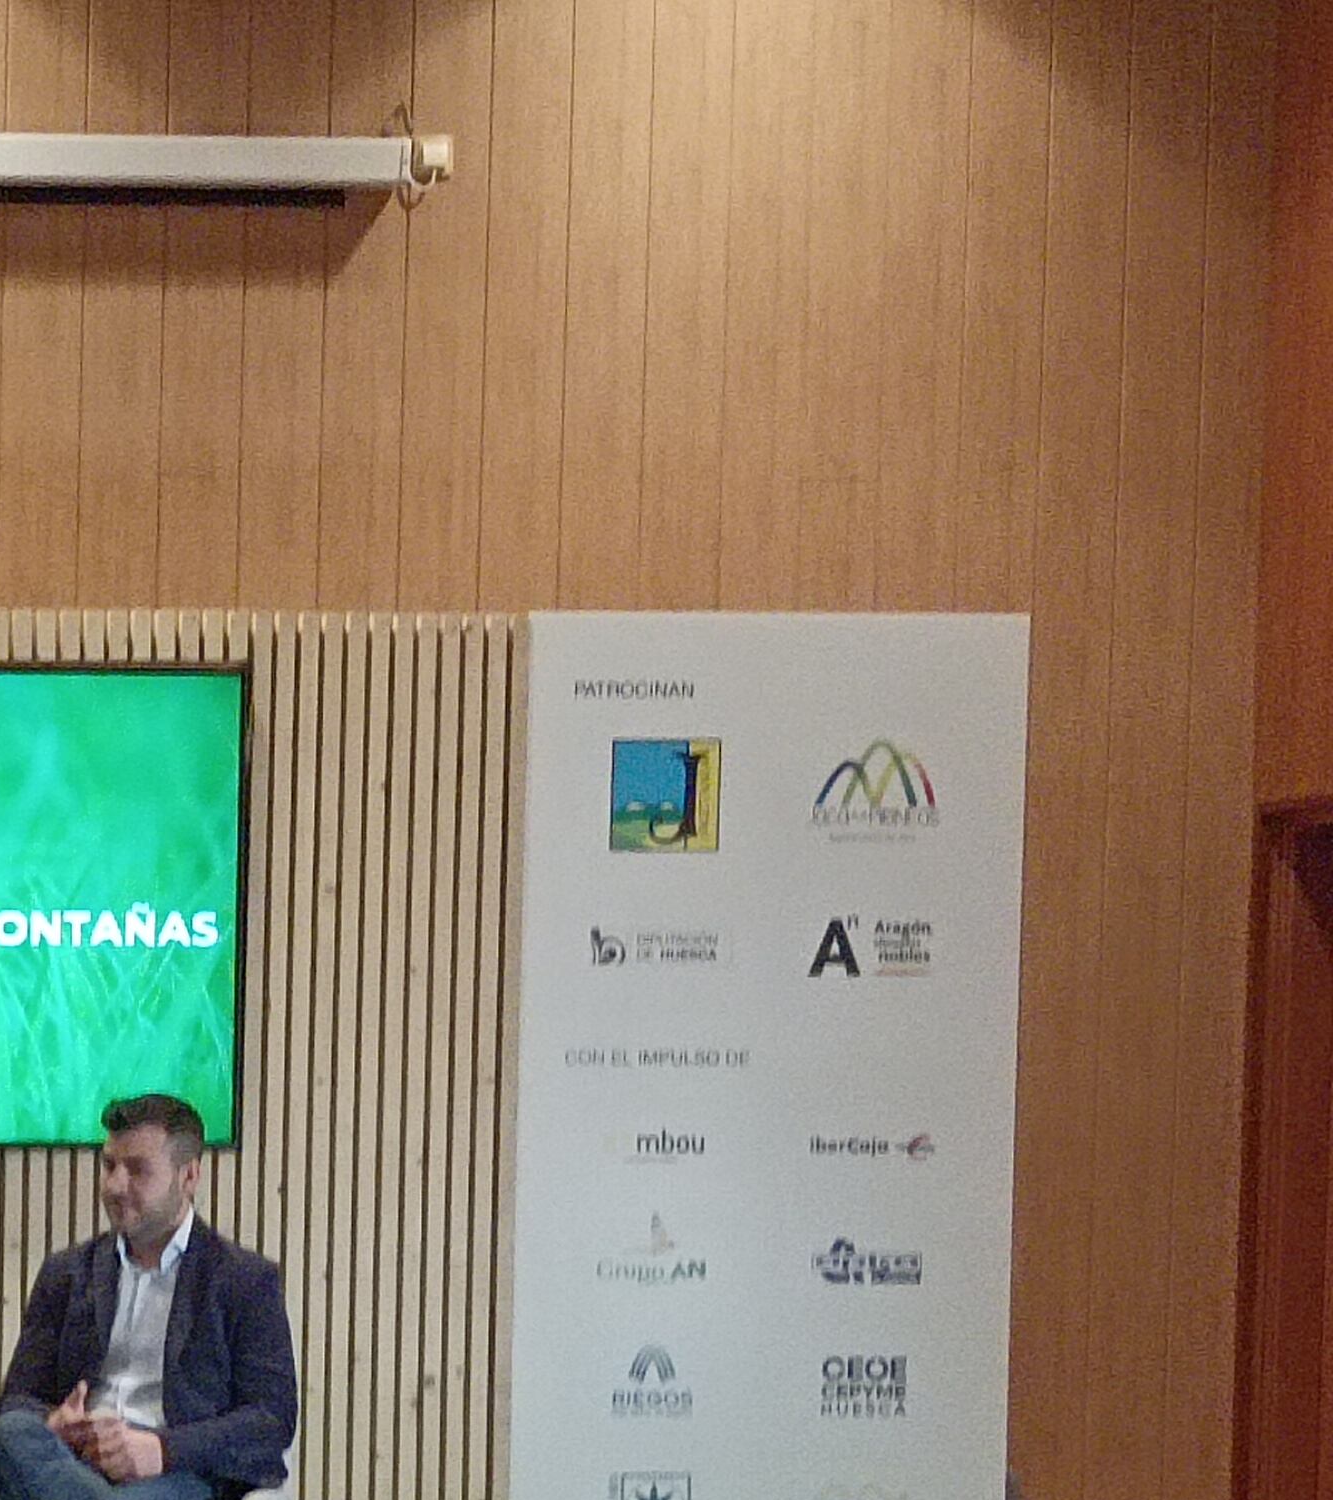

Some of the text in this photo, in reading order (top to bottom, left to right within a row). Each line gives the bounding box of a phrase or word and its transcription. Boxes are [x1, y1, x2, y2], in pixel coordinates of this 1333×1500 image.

[574, 680, 695, 699] PATROCINAN
[564, 1048, 606, 1068] CON
[637, 1048, 721, 1068] IMPULSO
[636, 1127, 706, 1155] mbou
